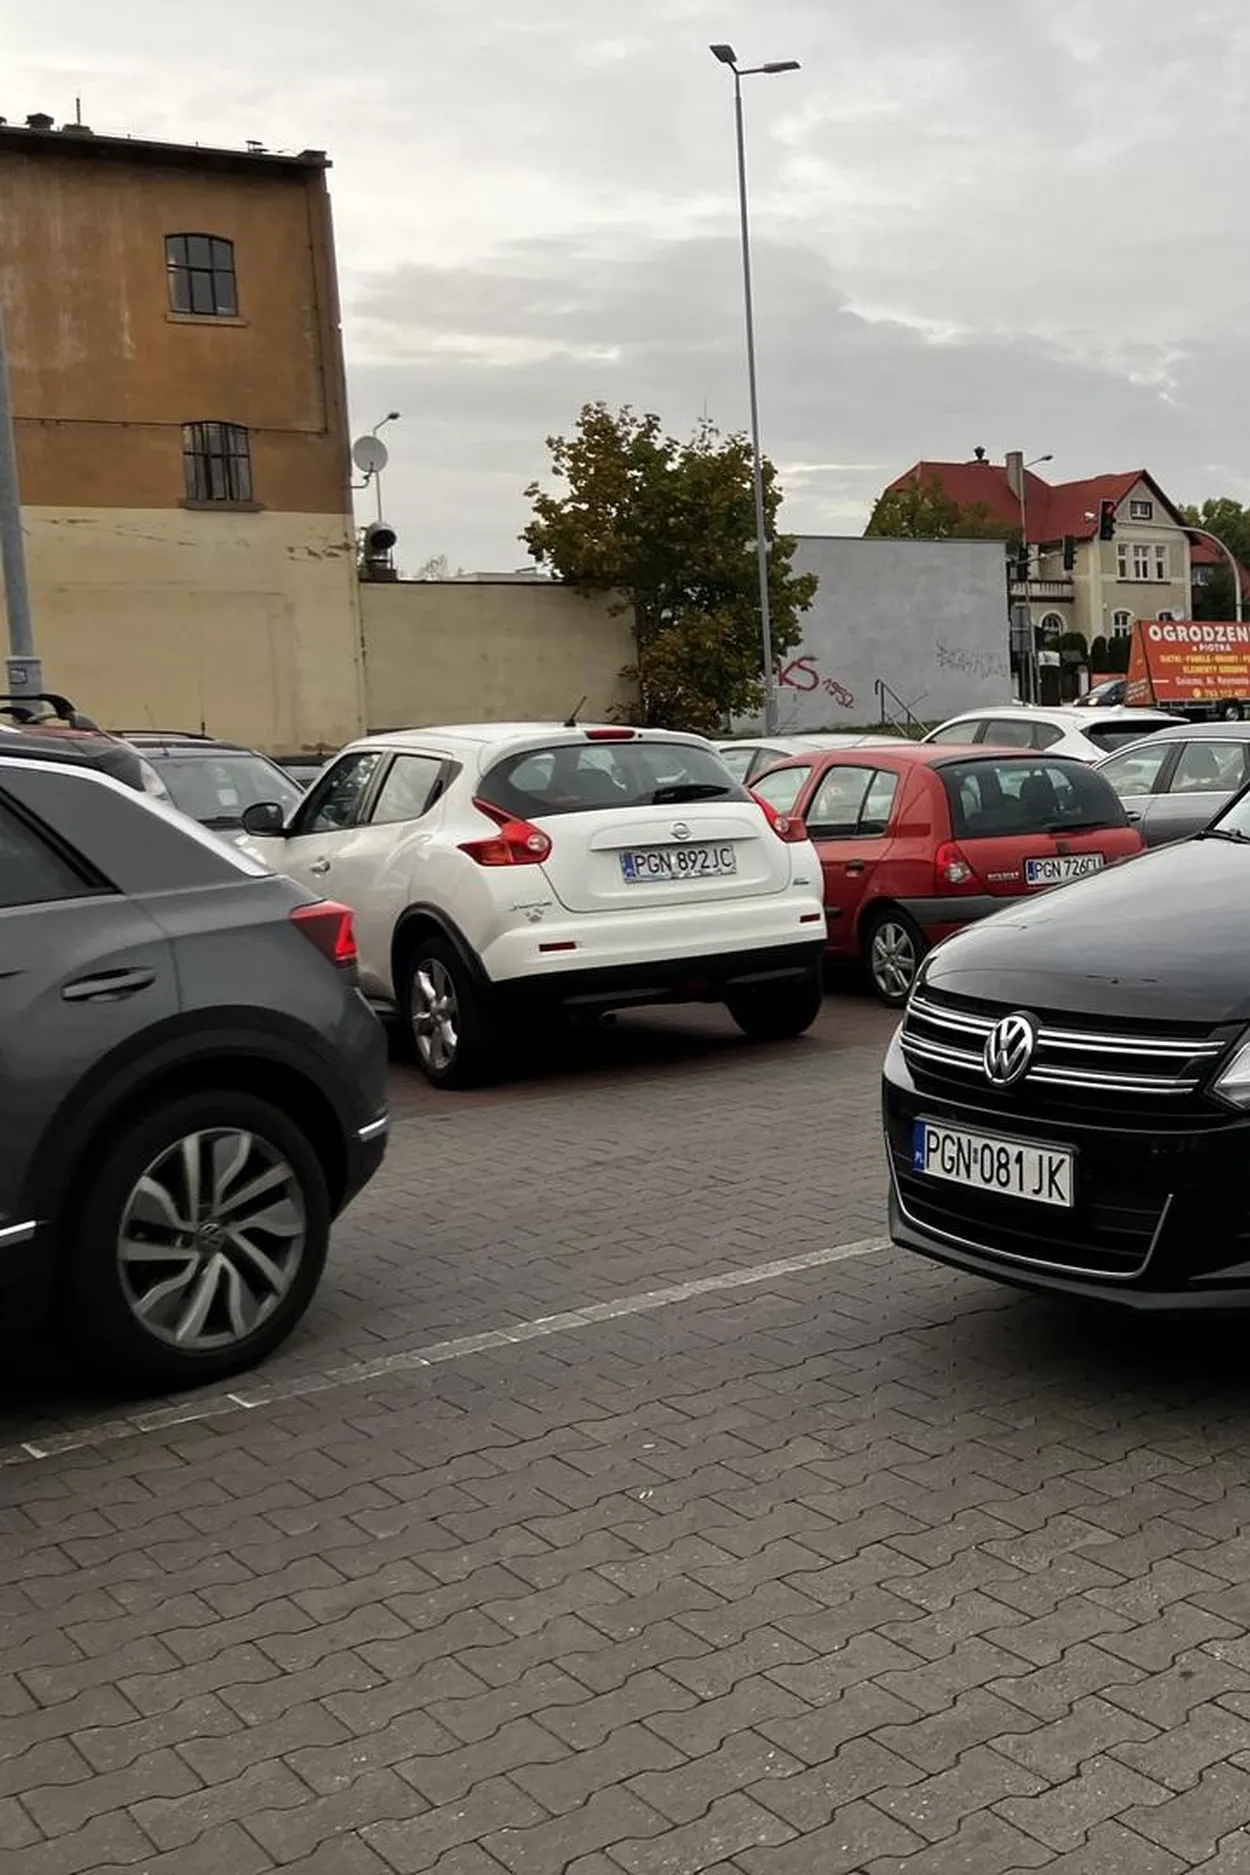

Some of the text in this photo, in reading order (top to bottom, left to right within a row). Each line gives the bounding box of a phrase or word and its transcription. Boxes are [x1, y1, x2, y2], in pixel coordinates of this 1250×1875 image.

[635, 848, 733, 875] PGN 892JC
[1035, 860, 1061, 878] PGN
[926, 1130, 1066, 1201] PGN 081JK
